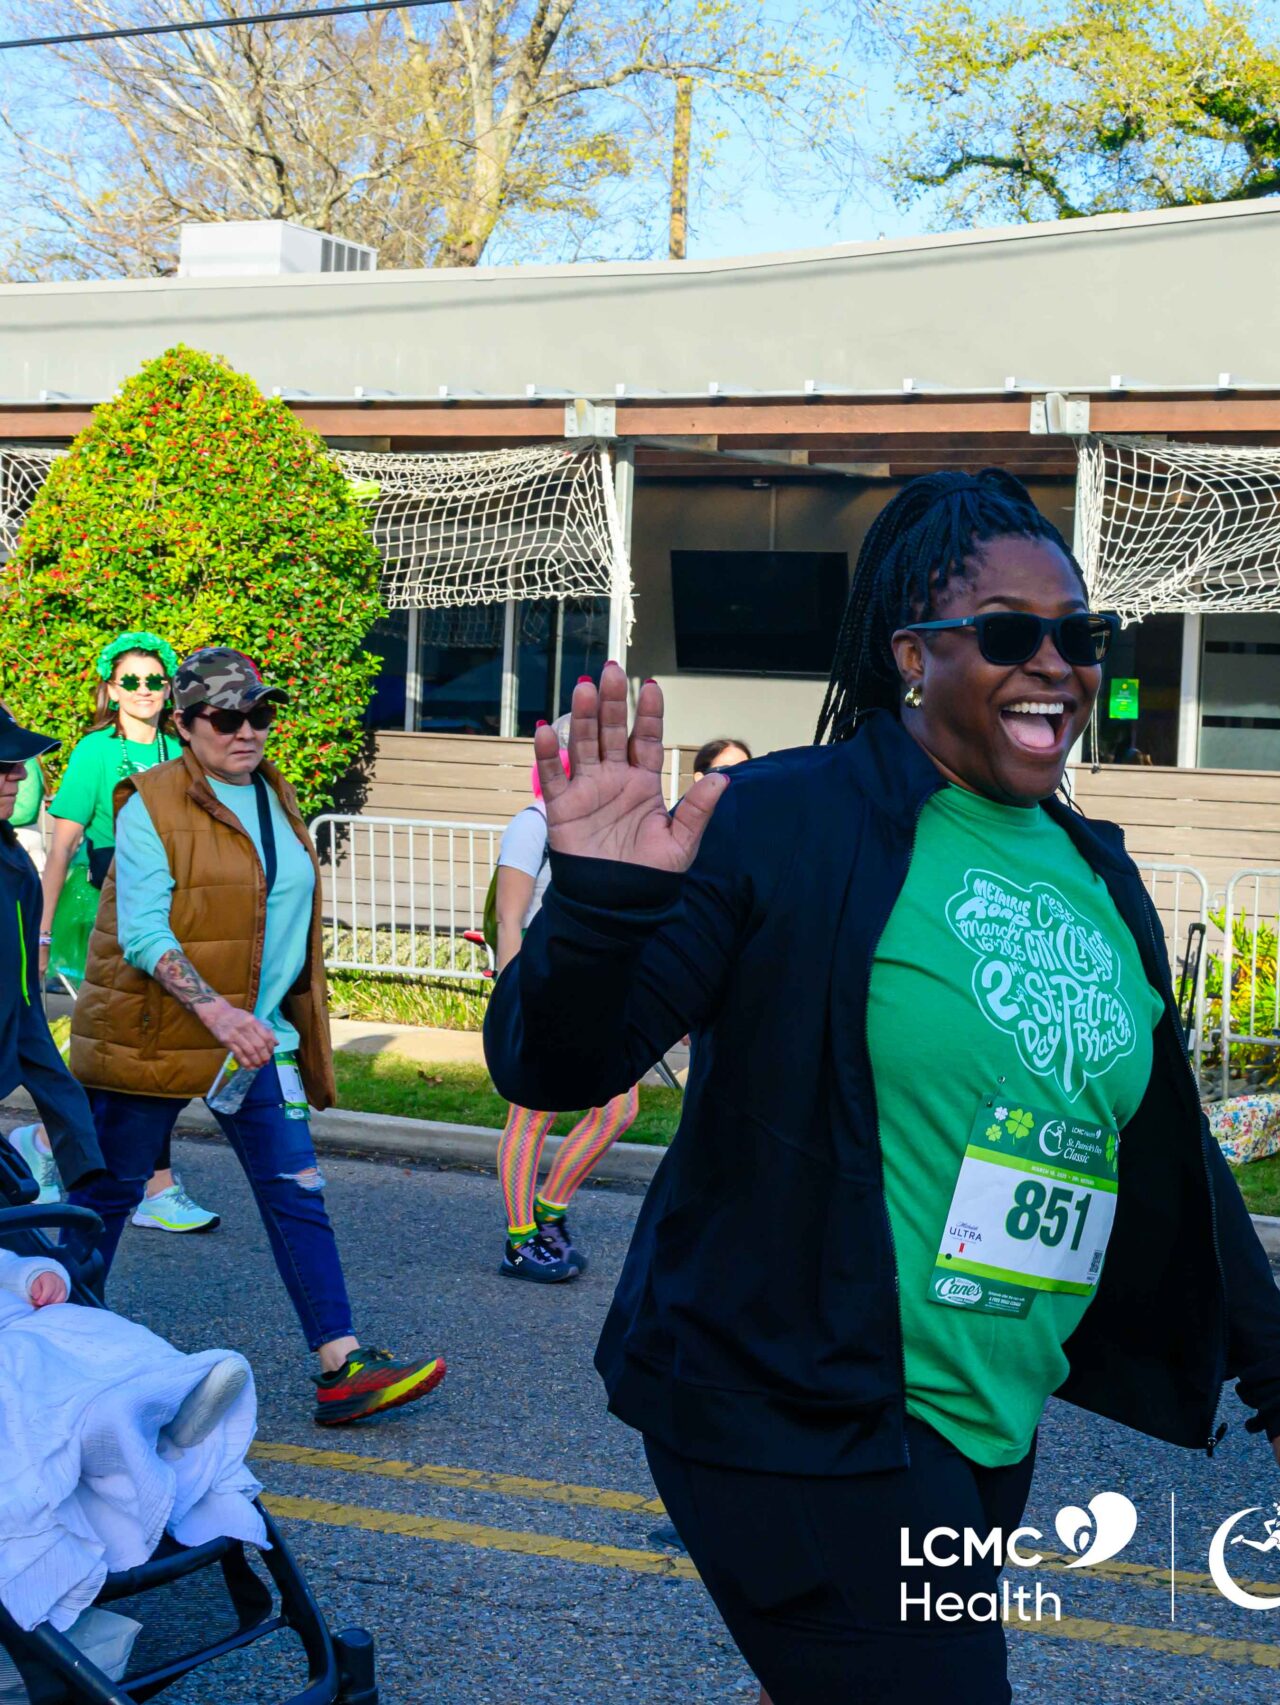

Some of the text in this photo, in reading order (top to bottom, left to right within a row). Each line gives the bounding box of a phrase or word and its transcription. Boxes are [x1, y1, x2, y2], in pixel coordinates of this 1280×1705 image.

[955, 896, 1031, 927] ROAD
[973, 878, 1031, 917] METAIRIE
[956, 919, 1024, 941] March
[997, 938, 1027, 962] 2025
[1024, 930, 1062, 971] CITY
[981, 960, 1021, 1021] 2
[1018, 1019, 1117, 1069] Day RACE
[1024, 970, 1132, 1092] St. Patrick's
[1063, 1147, 1090, 1164] Classic
[1066, 1138, 1103, 1156] St. Patrick's Day
[1005, 1179, 1092, 1251] 851
[949, 1226, 983, 1242] ULTRA
[936, 1276, 982, 1297] Cane's
